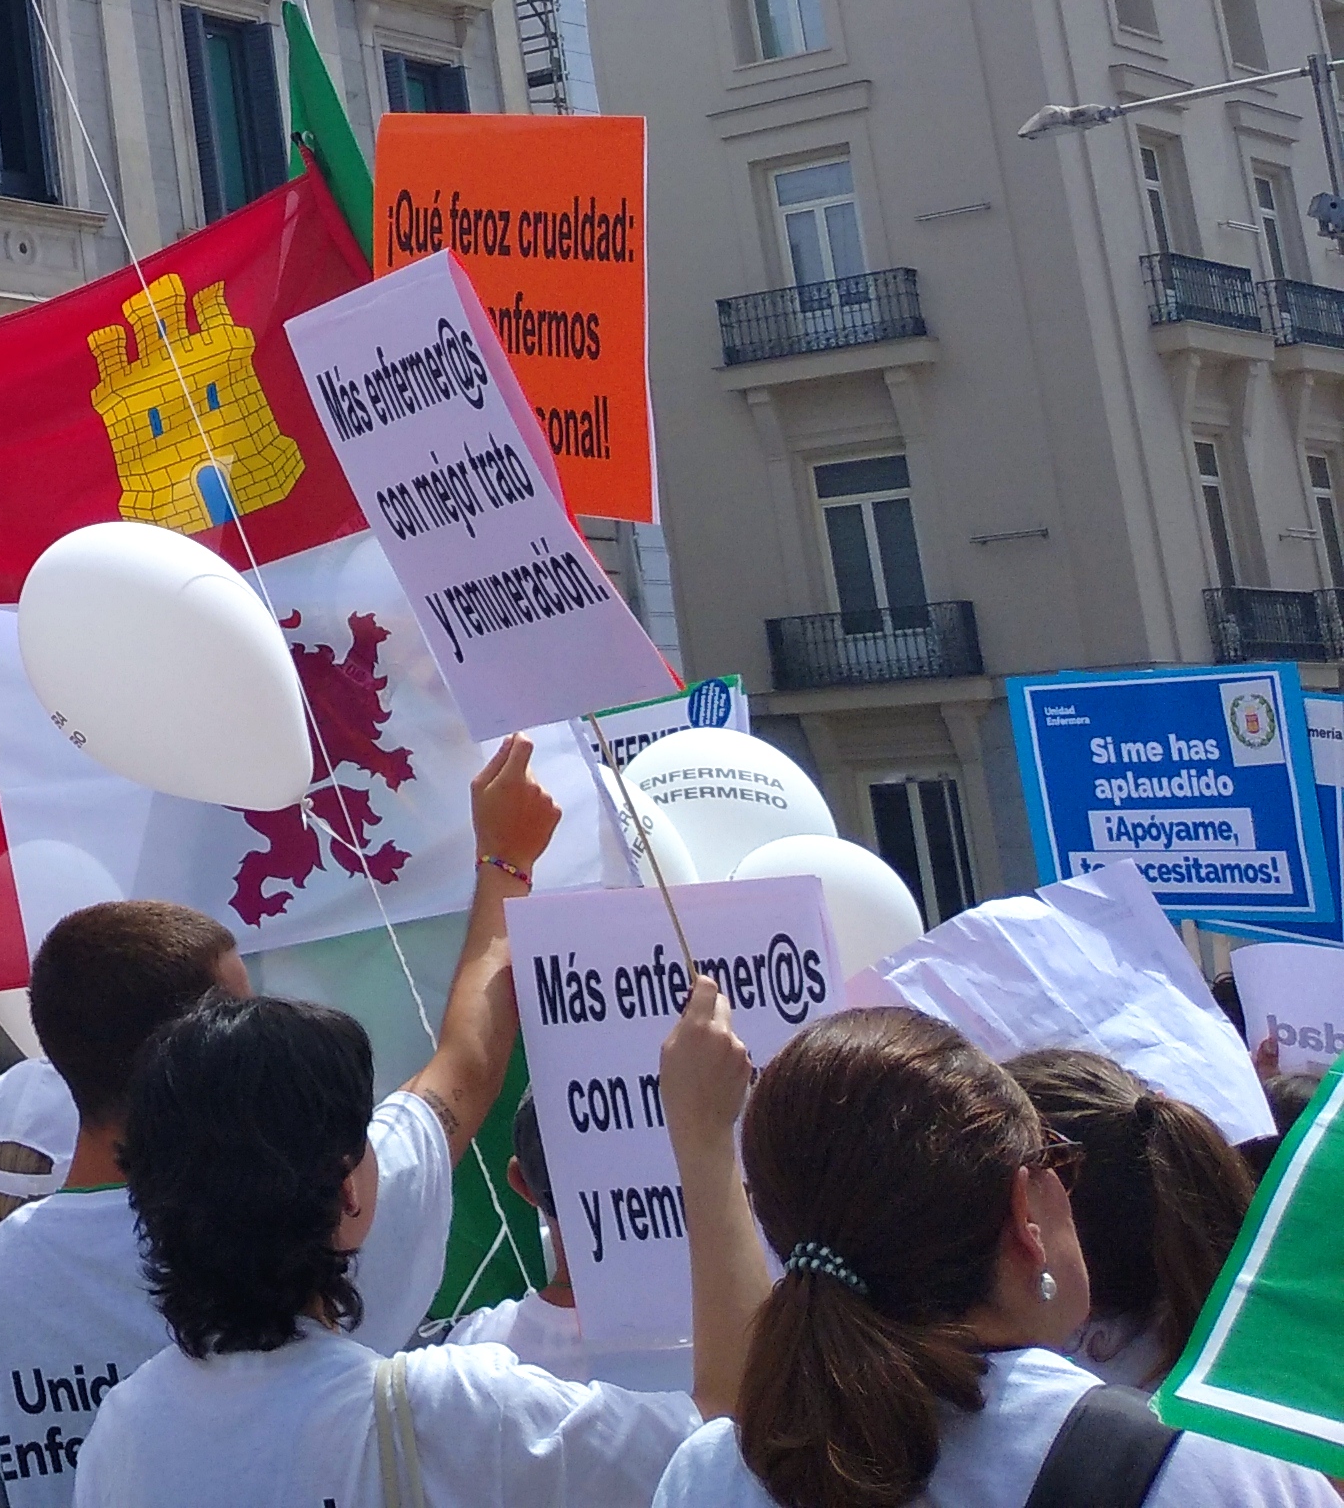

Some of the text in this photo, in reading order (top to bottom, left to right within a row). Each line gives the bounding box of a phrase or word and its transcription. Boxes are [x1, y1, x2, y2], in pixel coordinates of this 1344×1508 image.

[387, 188, 635, 268] ¡Qué feroz crueldad:
[316, 317, 488, 442] Más enfermer@s
[376, 431, 535, 542] con mejor trato
[424, 537, 611, 664] y remuneración.
[1044, 704, 1076, 717] Unidad
[1046, 715, 1091, 727] Enfermera
[1090, 733, 1221, 764] Si me has
[639, 767, 785, 792] ENFERMERA
[1094, 768, 1235, 807] aplaudido
[1104, 814, 1240, 850] ¡Apóyame,
[1138, 856, 1282, 885] cesitamos!
[533, 932, 827, 1026] Más enfemer@s
[566, 1074, 635, 1134] con
[578, 1189, 604, 1263] y
